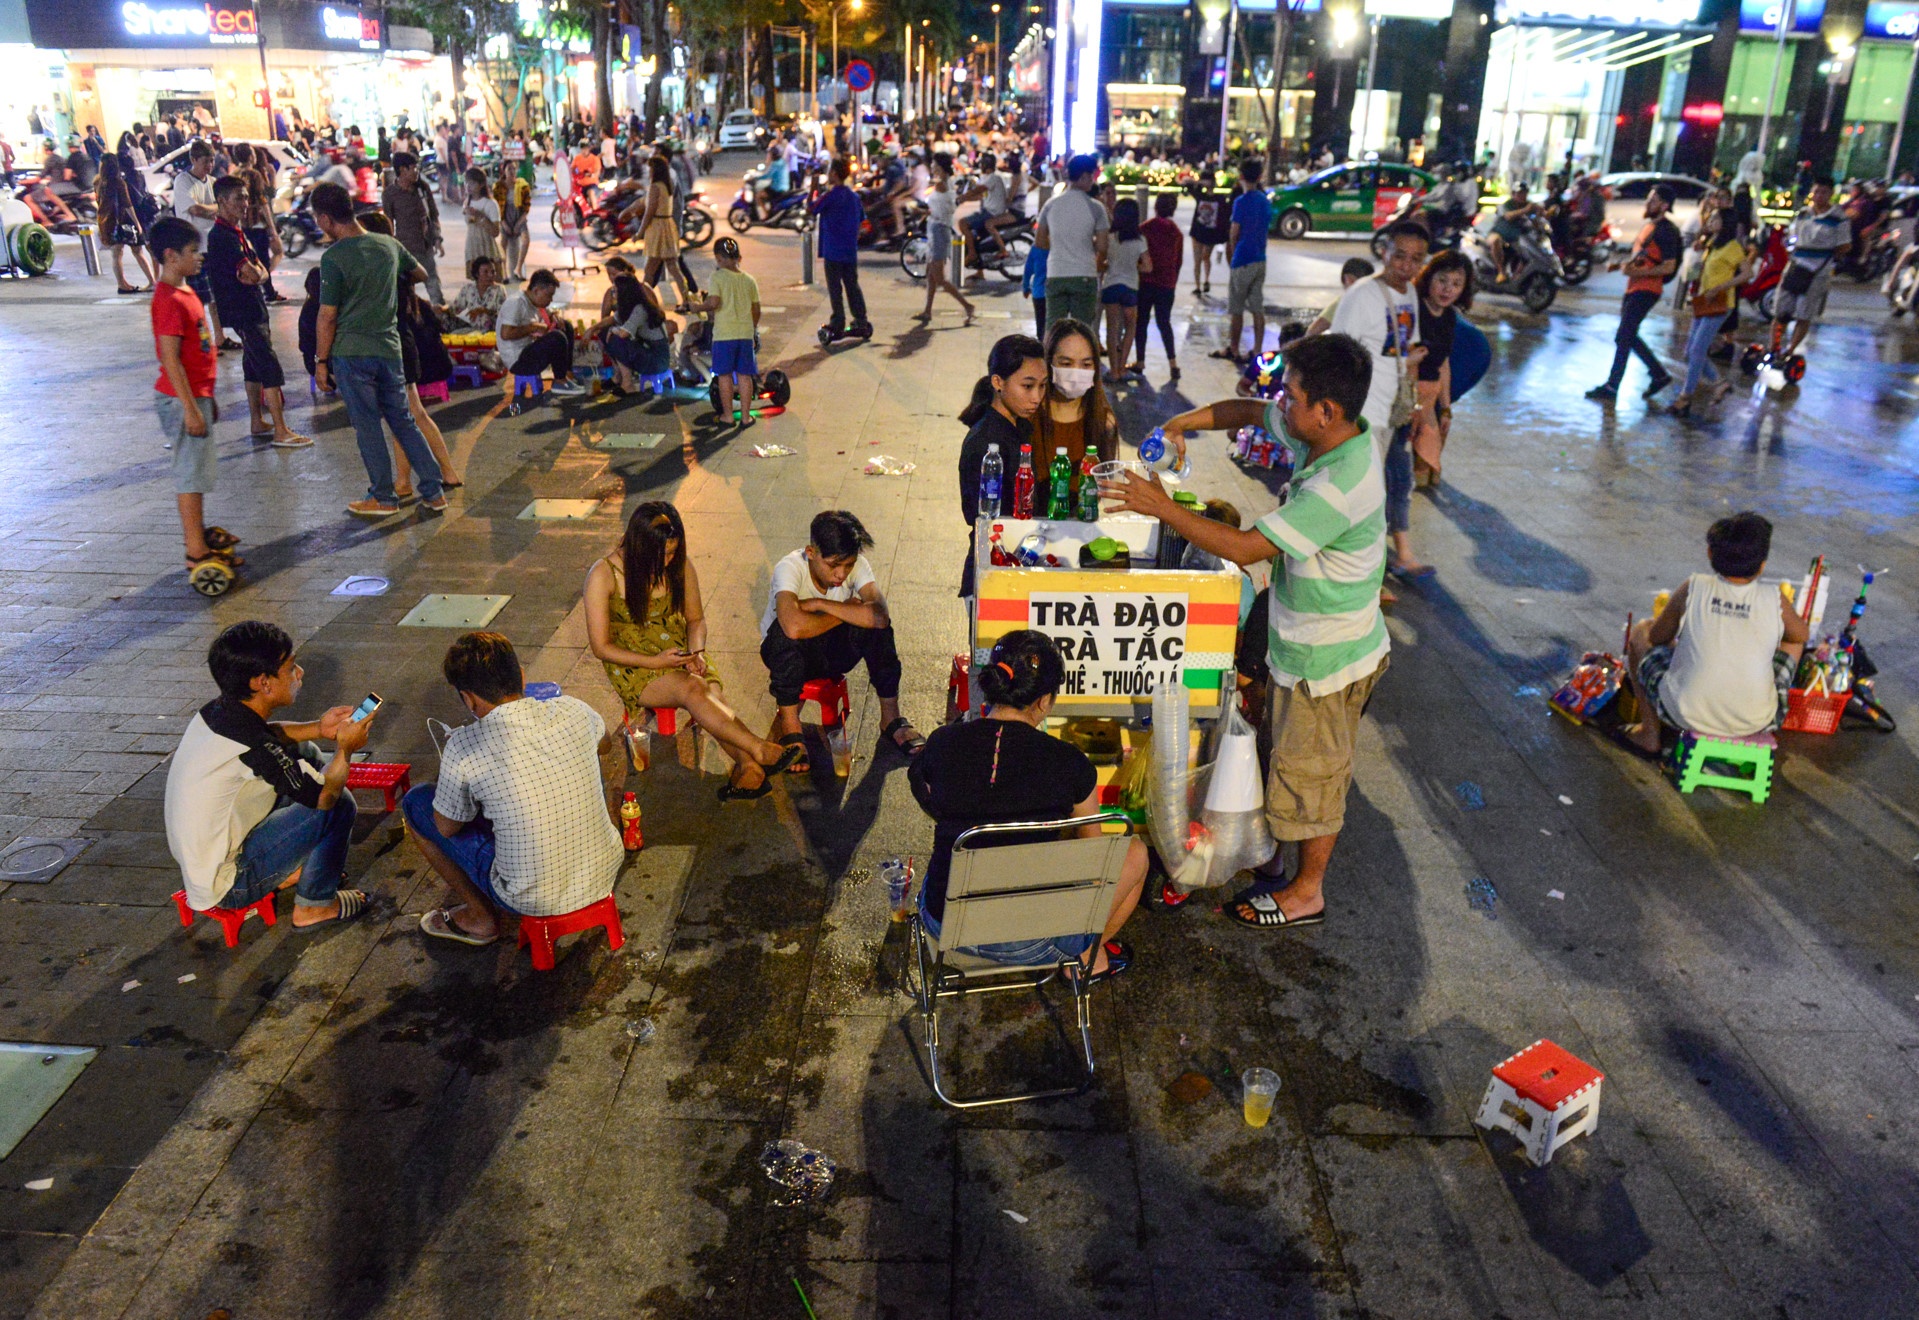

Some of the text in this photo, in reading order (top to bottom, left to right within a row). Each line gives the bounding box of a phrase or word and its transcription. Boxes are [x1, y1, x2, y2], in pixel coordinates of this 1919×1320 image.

[1031, 595, 1186, 628] TRÀ ĐÀO
[1053, 626, 1184, 661] RÀ TẮC
[1057, 664, 1086, 695] HÊ
[1102, 661, 1154, 695] THUỐC
